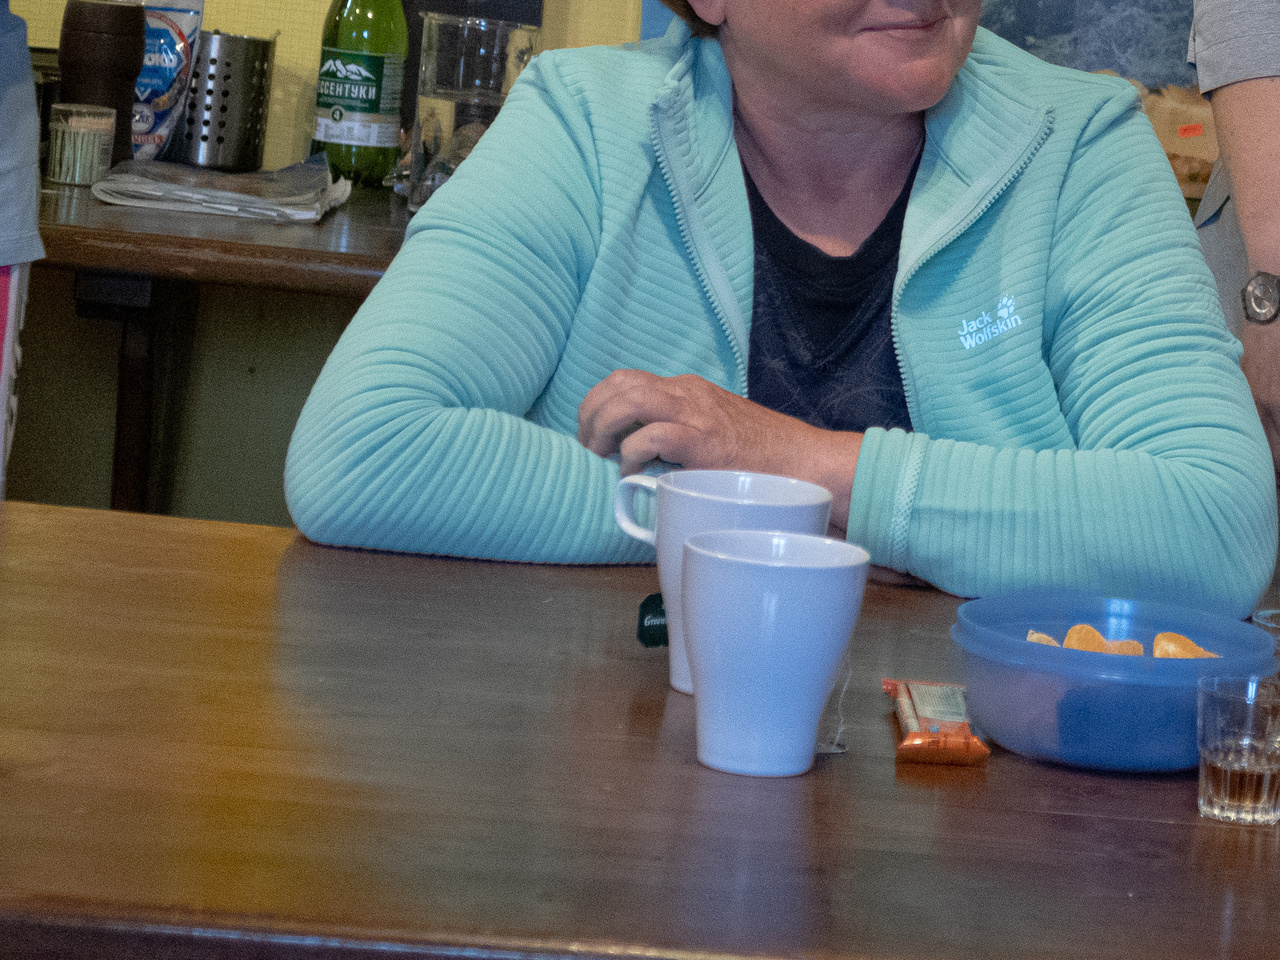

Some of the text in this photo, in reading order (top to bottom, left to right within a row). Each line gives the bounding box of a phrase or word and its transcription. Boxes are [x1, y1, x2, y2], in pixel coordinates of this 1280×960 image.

[318, 80, 377, 100] ССЕНТУКИ
[957, 311, 993, 335] Jack
[959, 314, 1023, 350] Wolfskin
[644, 615, 666, 627] Green
